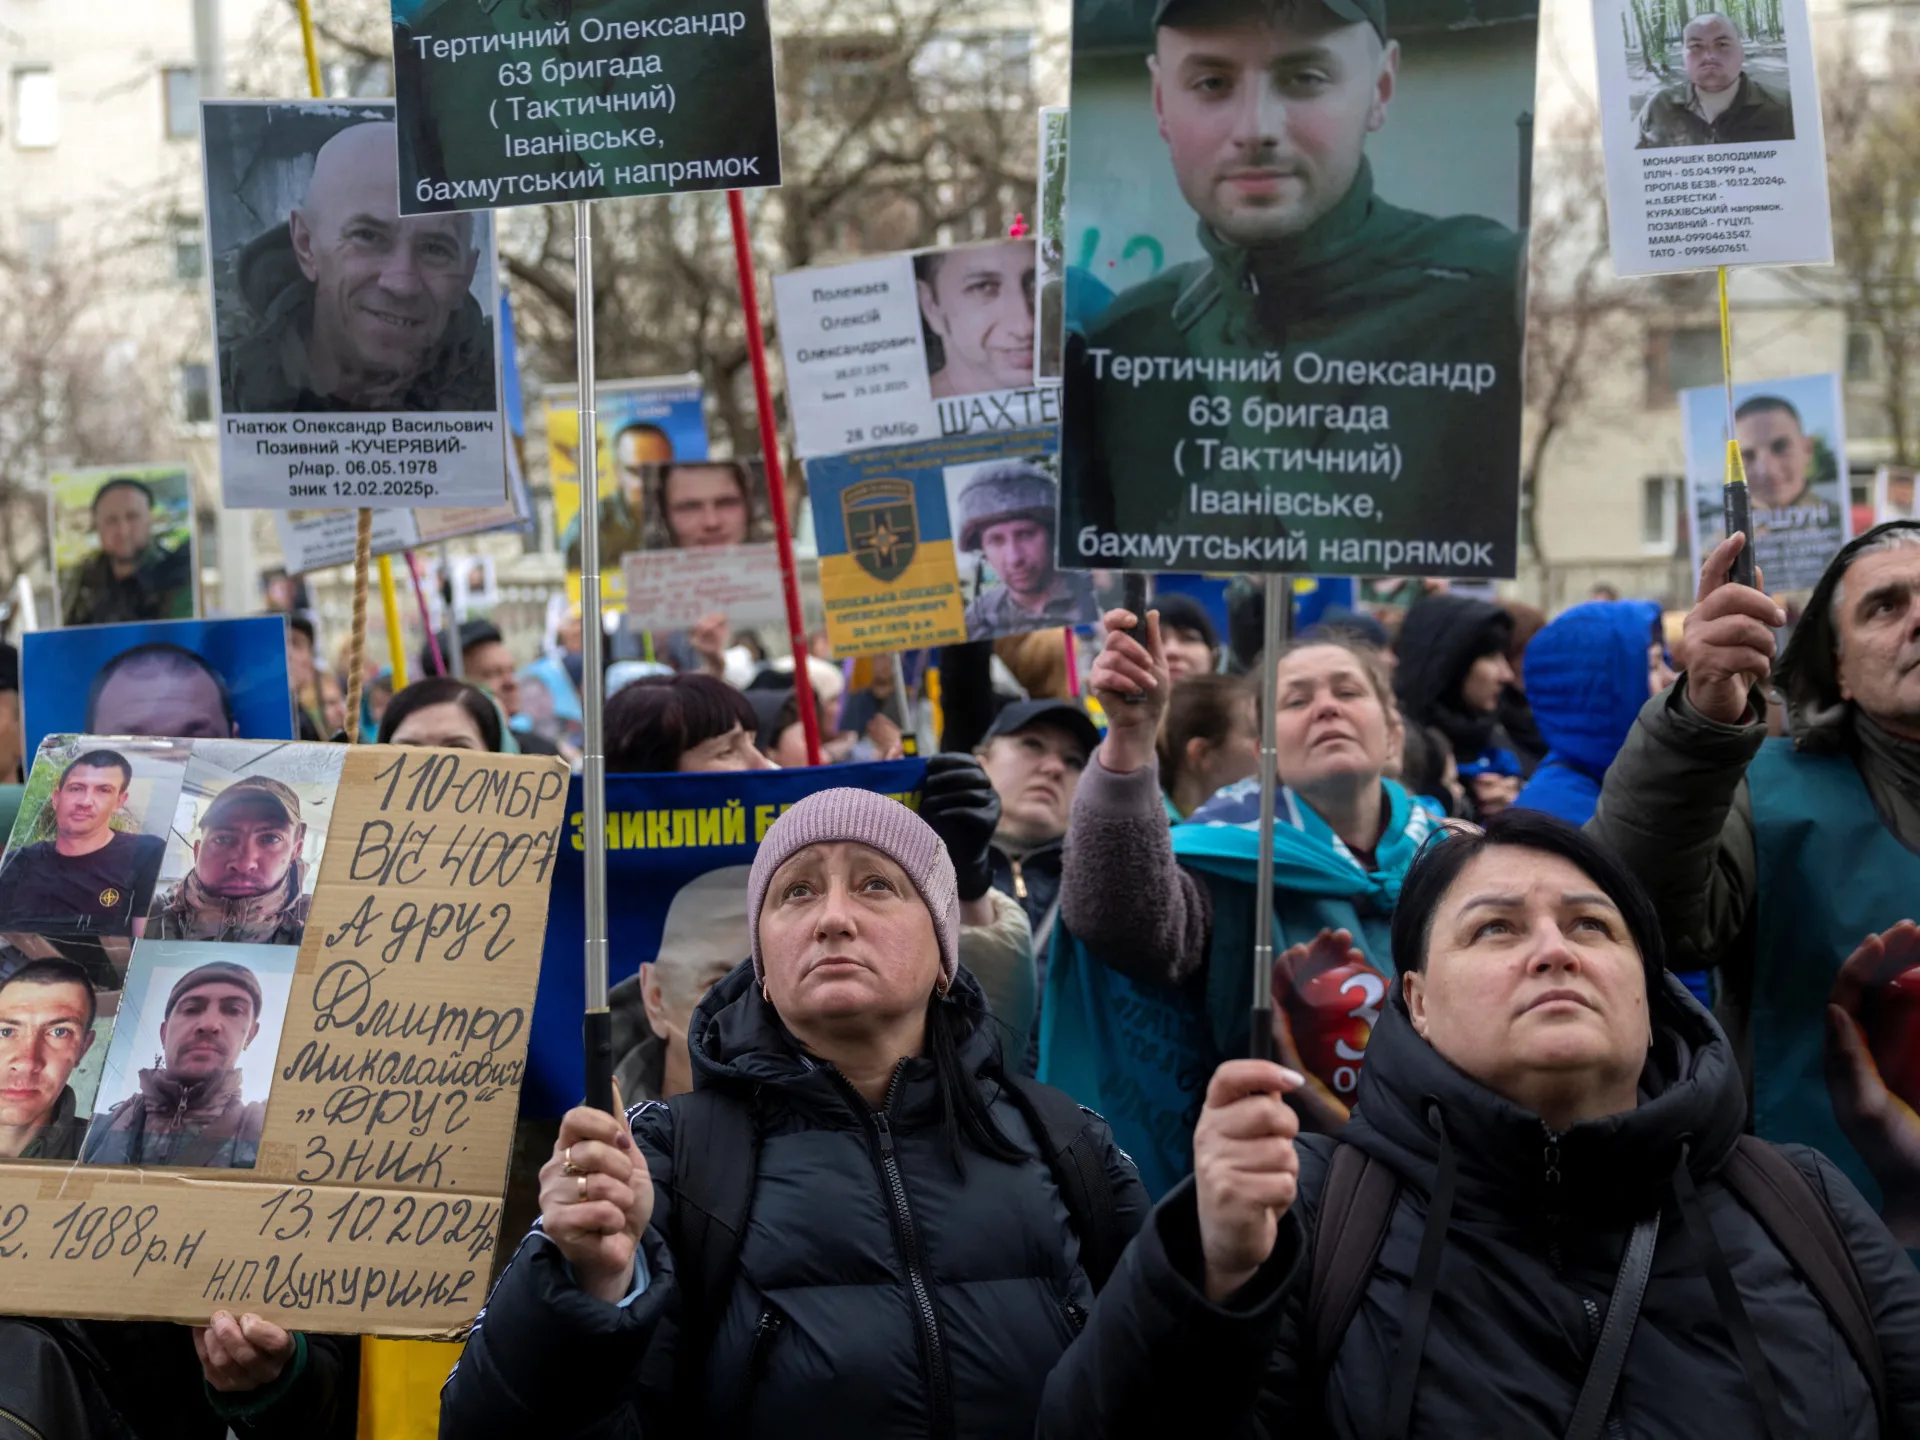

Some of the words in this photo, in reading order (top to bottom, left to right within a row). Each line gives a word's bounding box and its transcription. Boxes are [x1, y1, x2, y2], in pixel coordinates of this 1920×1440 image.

[413, 21, 570, 62] Тертичний
[580, 11, 746, 43] Олександр
[498, 62, 532, 87] 63
[541, 54, 662, 83] бригада
[505, 126, 664, 157] Іванівське,
[1643, 155, 1705, 167] МОНАРШЕК
[1707, 150, 1777, 162] ВОЛОДИМИР
[416, 164, 604, 202] бахмутський
[615, 155, 760, 184] напрямок
[1681, 166, 1736, 177] 05.04.1999
[1645, 181, 1689, 192] ПРОПАВ
[1646, 204, 1728, 218] КУРАХІВСЬКИЙ
[1731, 204, 1783, 214] напрямок.
[1647, 218, 1708, 232] ПОЗИВНИЙ
[1717, 216, 1753, 227] ГУЦУЛ.
[1649, 248, 1676, 258] ТАТО
[820, 308, 881, 331] Олексій
[796, 335, 917, 363] Олександрович
[1087, 349, 1281, 388] Тертичний
[1293, 352, 1496, 394] Олександр
[1188, 396, 1231, 427] 63
[1242, 396, 1389, 433] бригада
[226, 419, 288, 434] Гнатюк
[292, 420, 386, 436] Олександр
[391, 419, 494, 433] Васильович
[256, 440, 339, 455] Позивний
[344, 438, 467, 454] -КУЧЕРЯВИЙ-
[288, 461, 340, 477] р/нар.
[345, 460, 438, 475] 06.05.1978
[288, 483, 327, 496] зник
[333, 481, 439, 498] 12.02.2025р.
[1190, 485, 1383, 521] Іванівське,
[1078, 527, 1308, 565] бахмутський
[1319, 538, 1495, 570] напрямок
